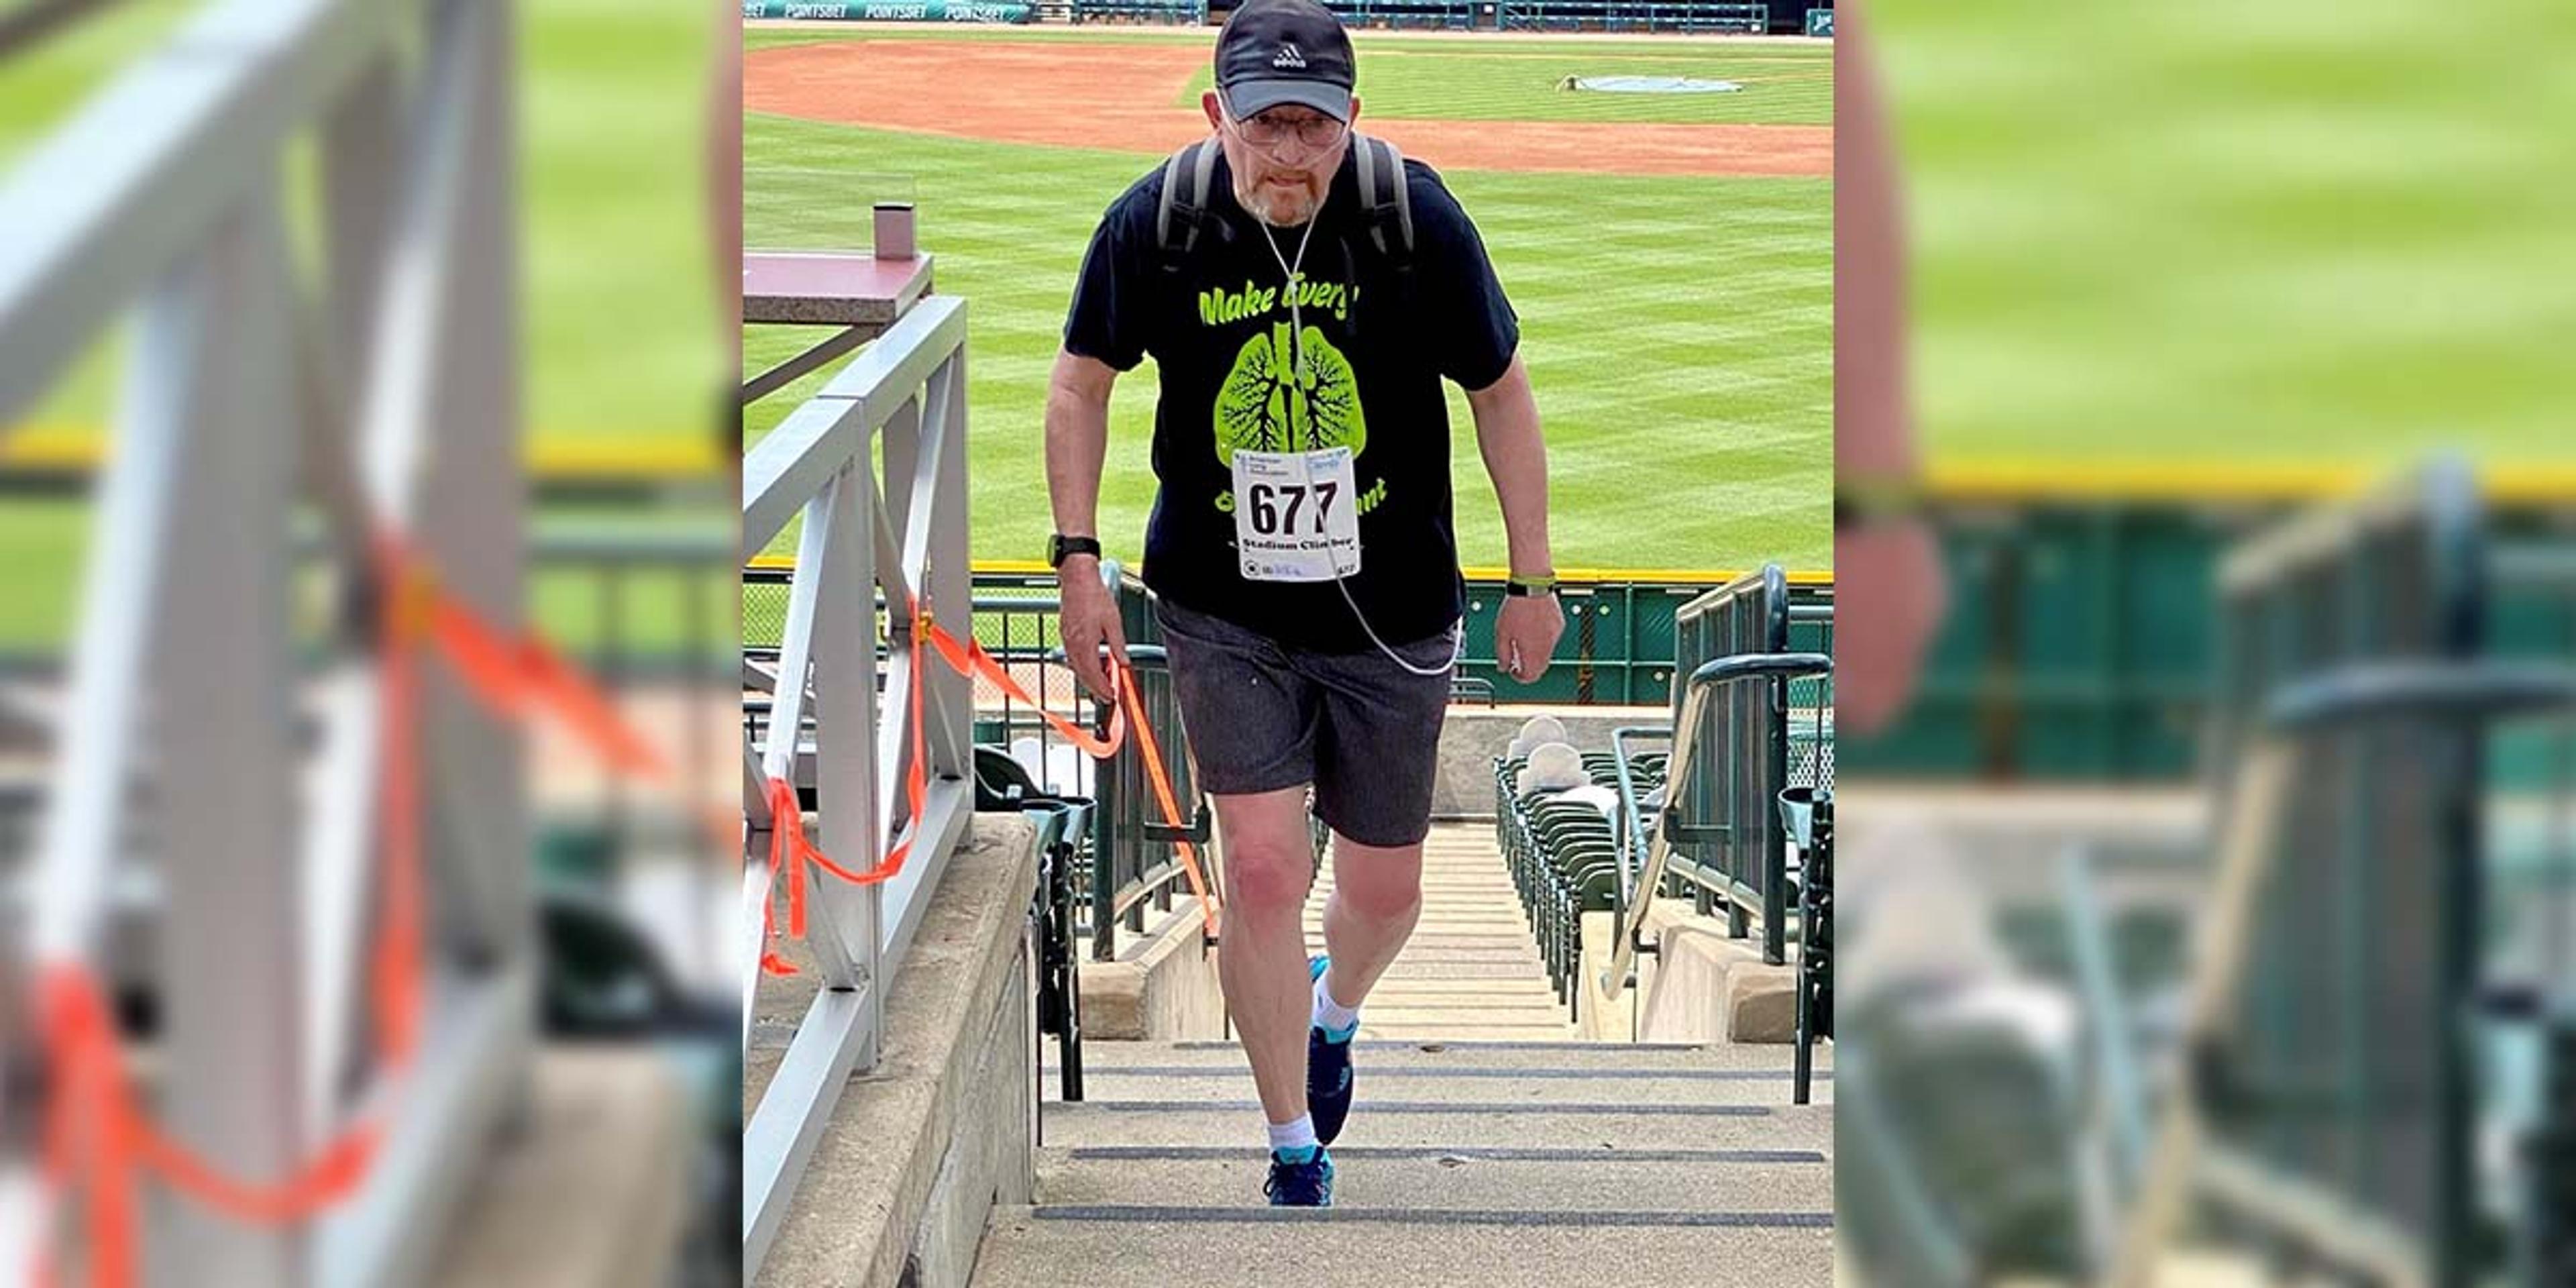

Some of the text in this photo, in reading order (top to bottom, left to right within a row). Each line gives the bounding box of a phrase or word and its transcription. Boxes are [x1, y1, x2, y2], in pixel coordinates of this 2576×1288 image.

[784, 3, 848, 19] POINTSBET
[865, 4, 928, 19] POINTSBET
[1199, 279, 1276, 325] Make
[1249, 481, 1338, 535] 677
[1242, 538, 1298, 550] Stadium
